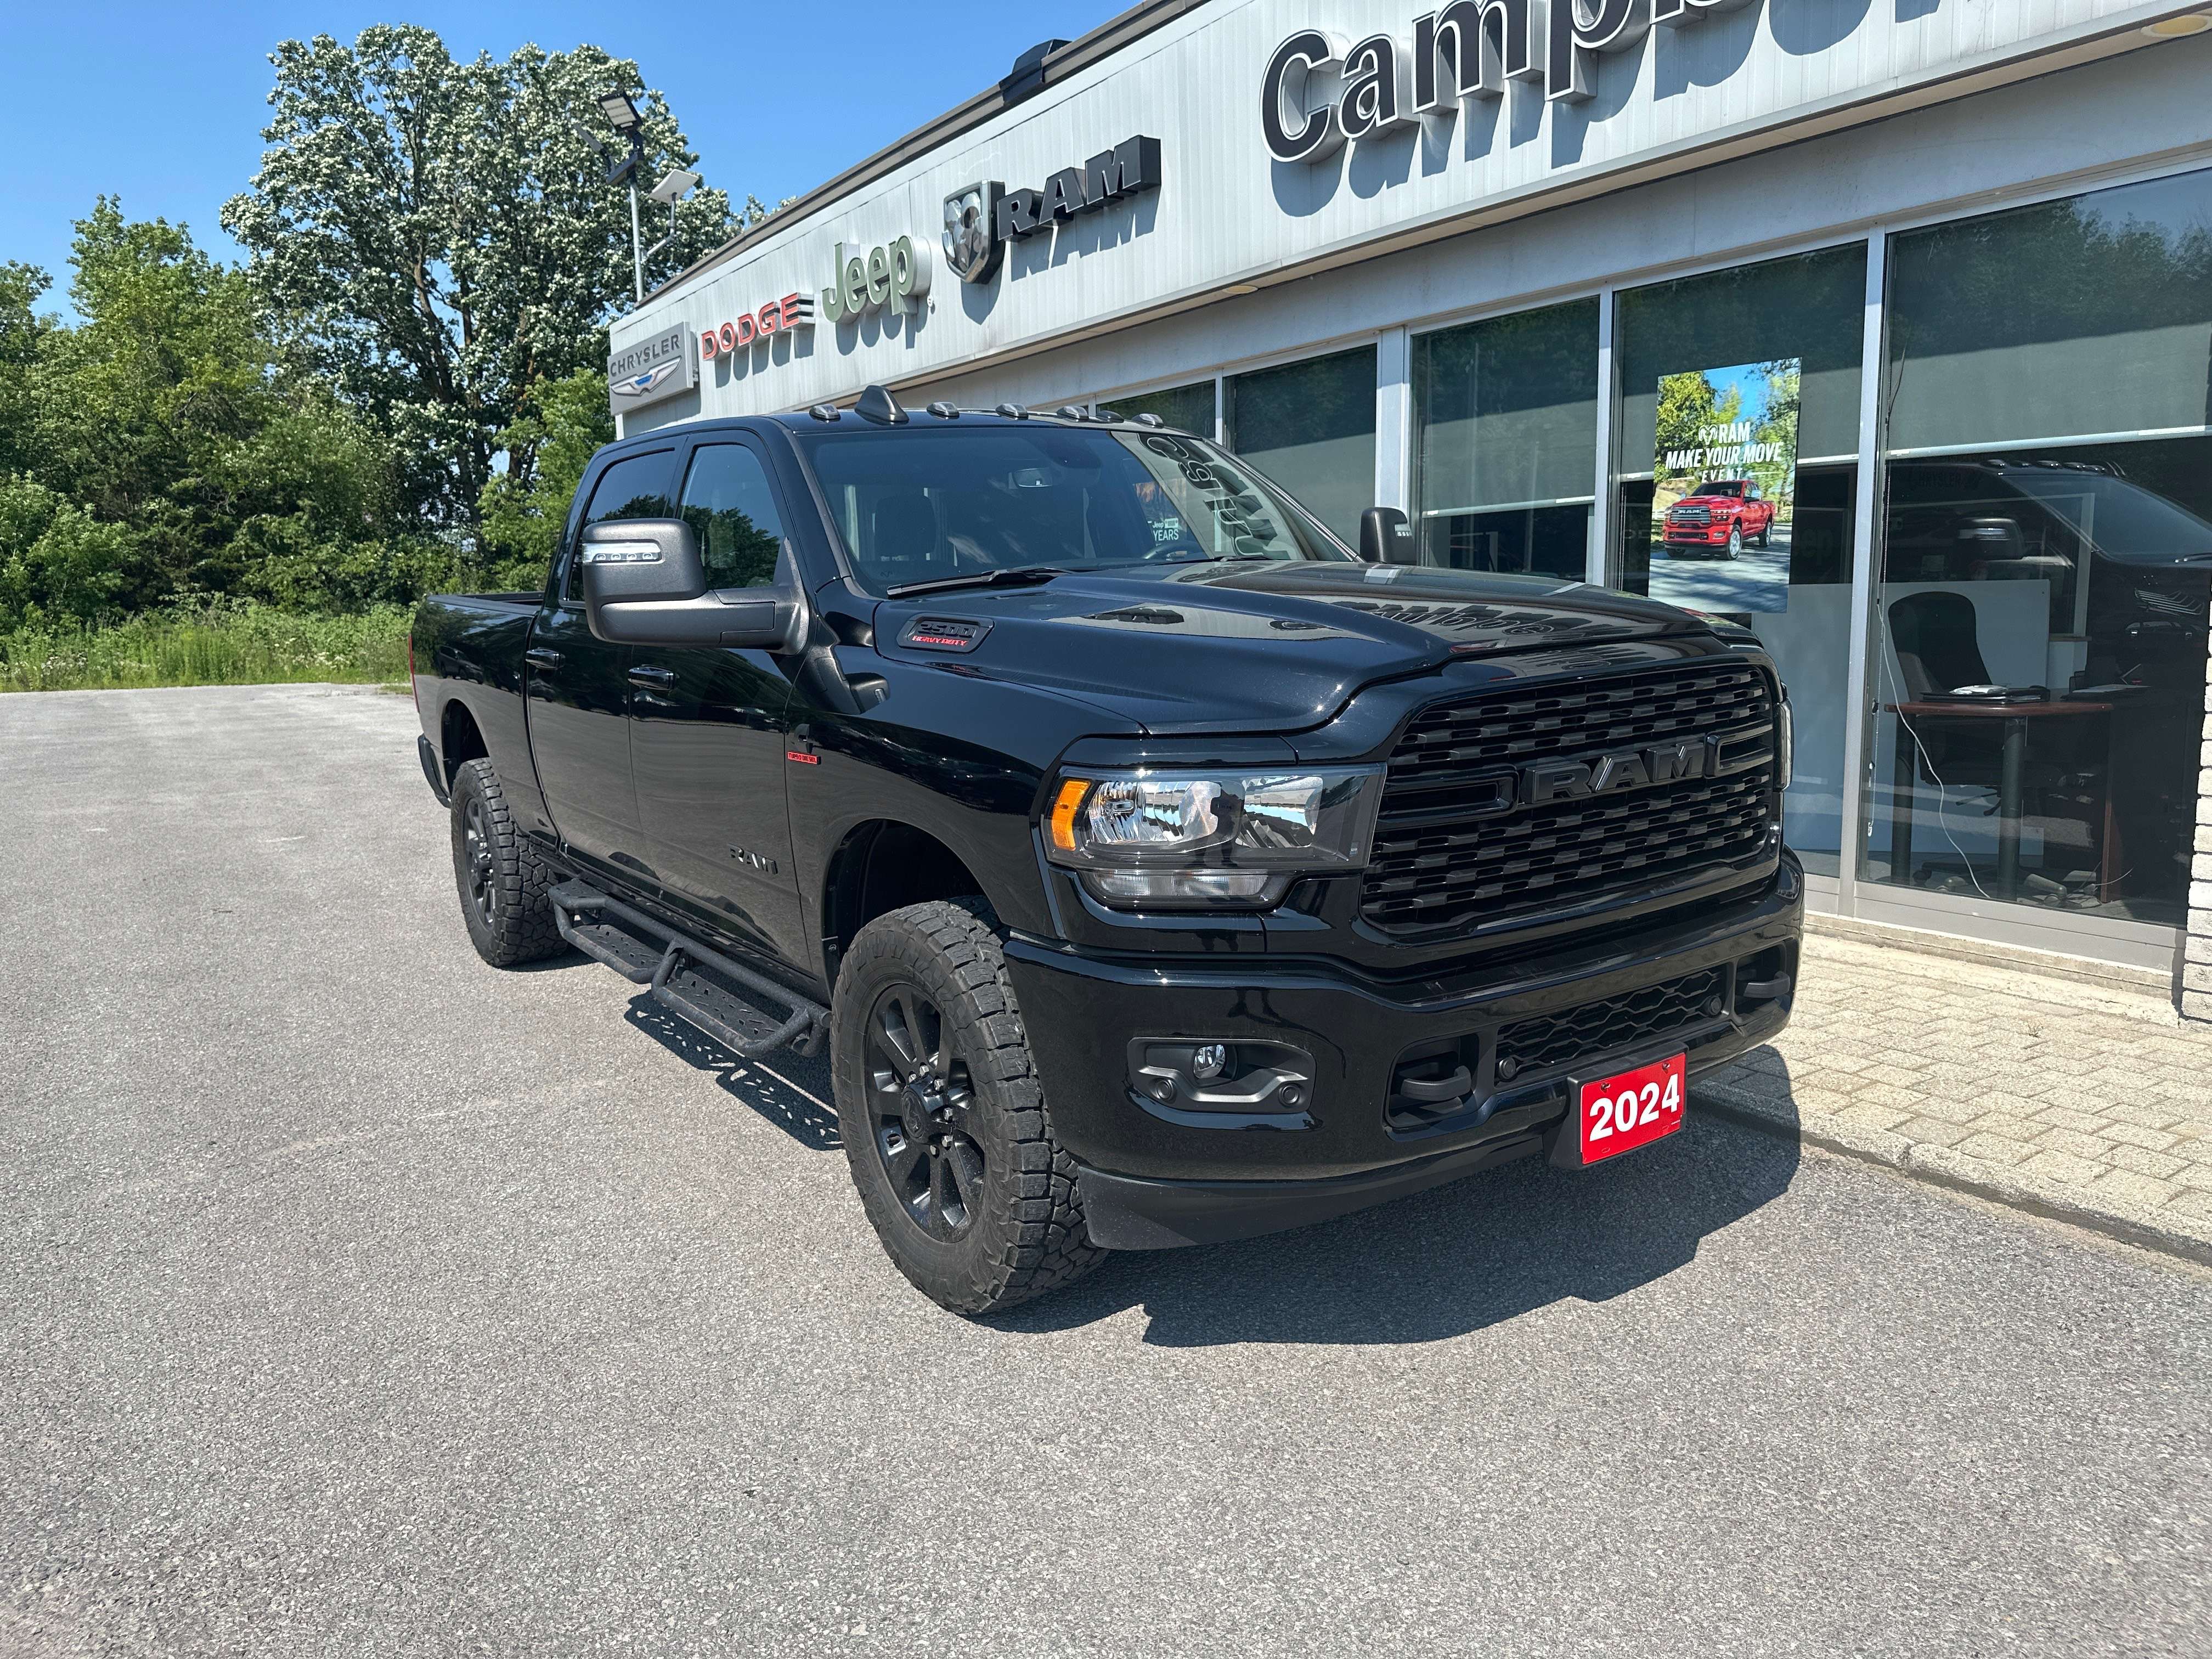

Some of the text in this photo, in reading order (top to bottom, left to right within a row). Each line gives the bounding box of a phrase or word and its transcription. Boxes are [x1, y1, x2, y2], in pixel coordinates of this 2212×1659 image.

[1259, 0, 1723, 163] Camp
[997, 134, 1147, 241] RAM
[821, 235, 917, 323] Jeep
[701, 292, 801, 360] DODGE
[610, 334, 681, 377] CHRYSLER
[1718, 421, 1751, 443] RAM
[1664, 442, 1784, 469] MAKE YOUR MOVE
[1701, 467, 1743, 483] EVENT
[1153, 529, 1179, 541] YEARS
[911, 635, 941, 644] HEAVY
[918, 623, 977, 637] 2500
[1522, 742, 1705, 805] RAM
[727, 843, 778, 875] RAM
[1589, 1073, 1680, 1142] 2024
